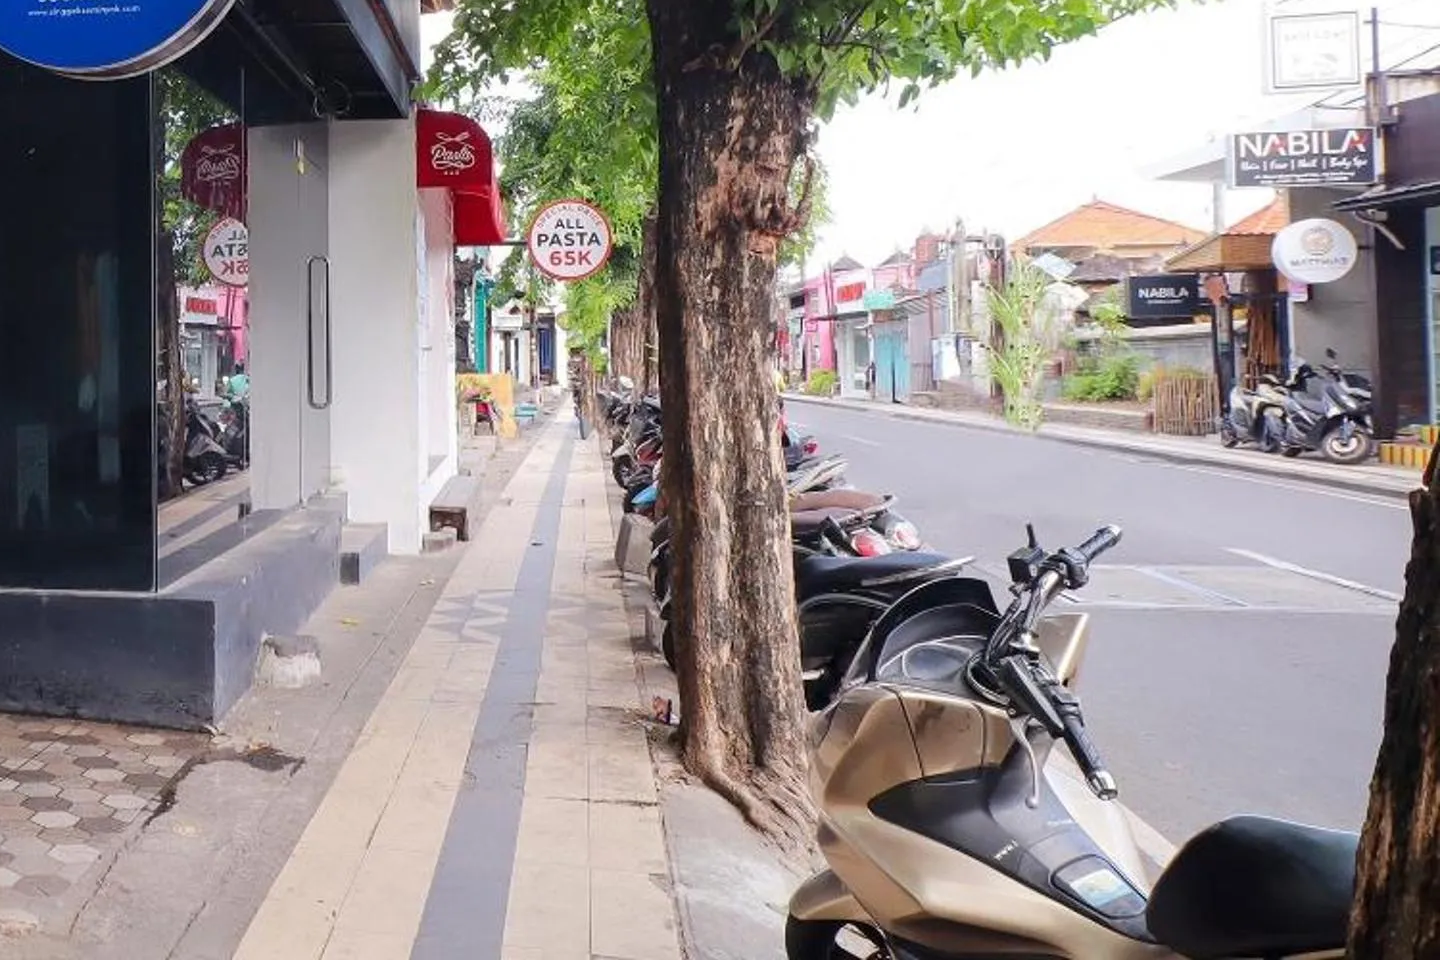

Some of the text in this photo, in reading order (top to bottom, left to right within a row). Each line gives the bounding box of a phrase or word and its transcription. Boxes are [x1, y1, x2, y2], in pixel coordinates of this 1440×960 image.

[1239, 130, 1367, 158] NABILA
[554, 218, 585, 229] ALL
[537, 231, 601, 247] PASTA
[549, 250, 593, 266] 65K
[1137, 287, 1190, 299] NABILA
